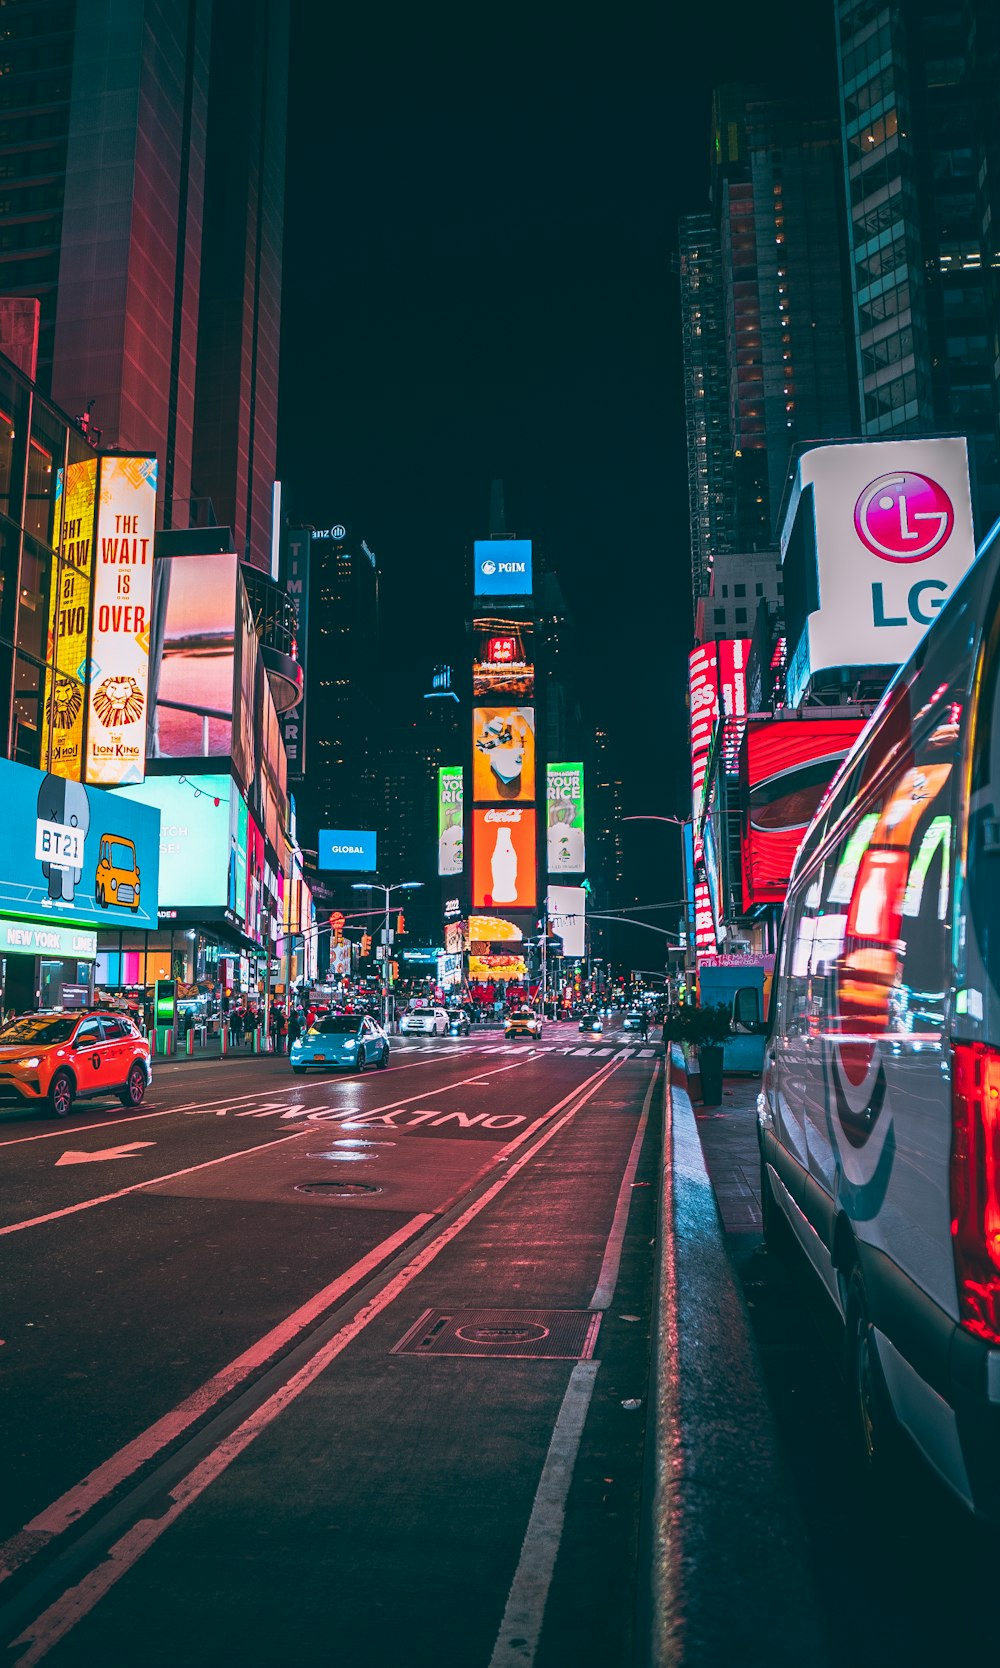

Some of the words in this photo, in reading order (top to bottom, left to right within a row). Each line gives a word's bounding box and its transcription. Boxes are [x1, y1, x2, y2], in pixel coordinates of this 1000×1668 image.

[115, 515, 139, 534] THE
[312, 529, 330, 540] anz
[101, 537, 150, 565] WAIT
[498, 562, 526, 573] PGIM
[117, 574, 131, 594] IS
[871, 579, 950, 627] LG
[98, 604, 146, 633] OVER
[547, 776, 580, 787] YOUR
[547, 786, 581, 800] RICE
[42, 829, 78, 859] BT21
[331, 845, 365, 854] GLOBAL
[7, 927, 33, 946] NEW
[34, 931, 60, 949] YORK
[355, 1109, 528, 1129] ONLY
